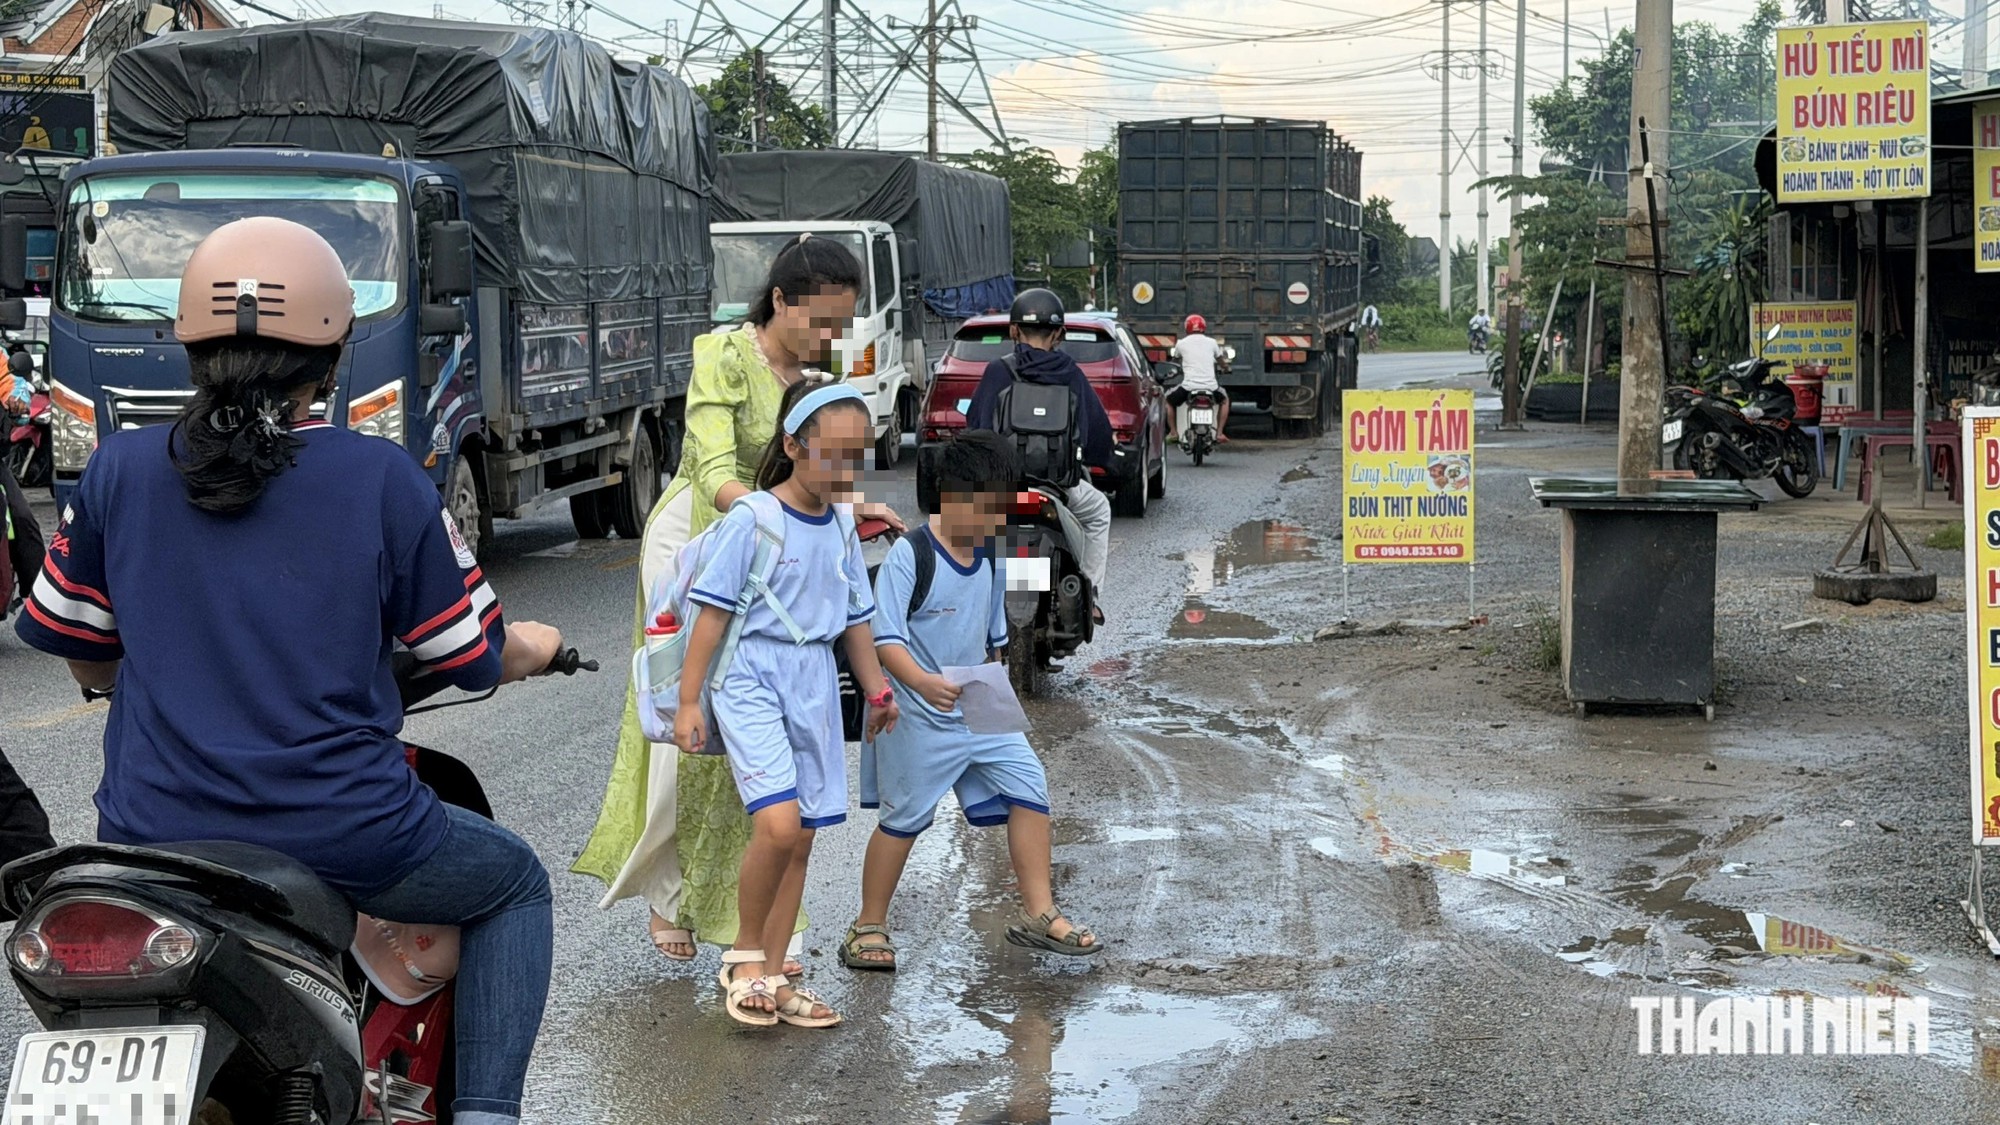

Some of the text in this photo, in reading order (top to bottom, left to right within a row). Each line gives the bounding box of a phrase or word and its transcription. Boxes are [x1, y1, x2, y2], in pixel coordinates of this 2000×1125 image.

[1784, 28, 1924, 76] HỦ TIẾU MÌ
[1793, 82, 1915, 129] BÚN RIÊU
[1808, 138, 1837, 162] BÁNH
[1840, 140, 1869, 161] CANH
[1885, 168, 1901, 192] VỊT
[1350, 393, 1469, 452] CƠM TẤM
[1349, 491, 1468, 522] BÚN THỊT NƯỚNG
[284, 970, 344, 1011] SIRIUS
[42, 1036, 168, 1086] 69-D1
